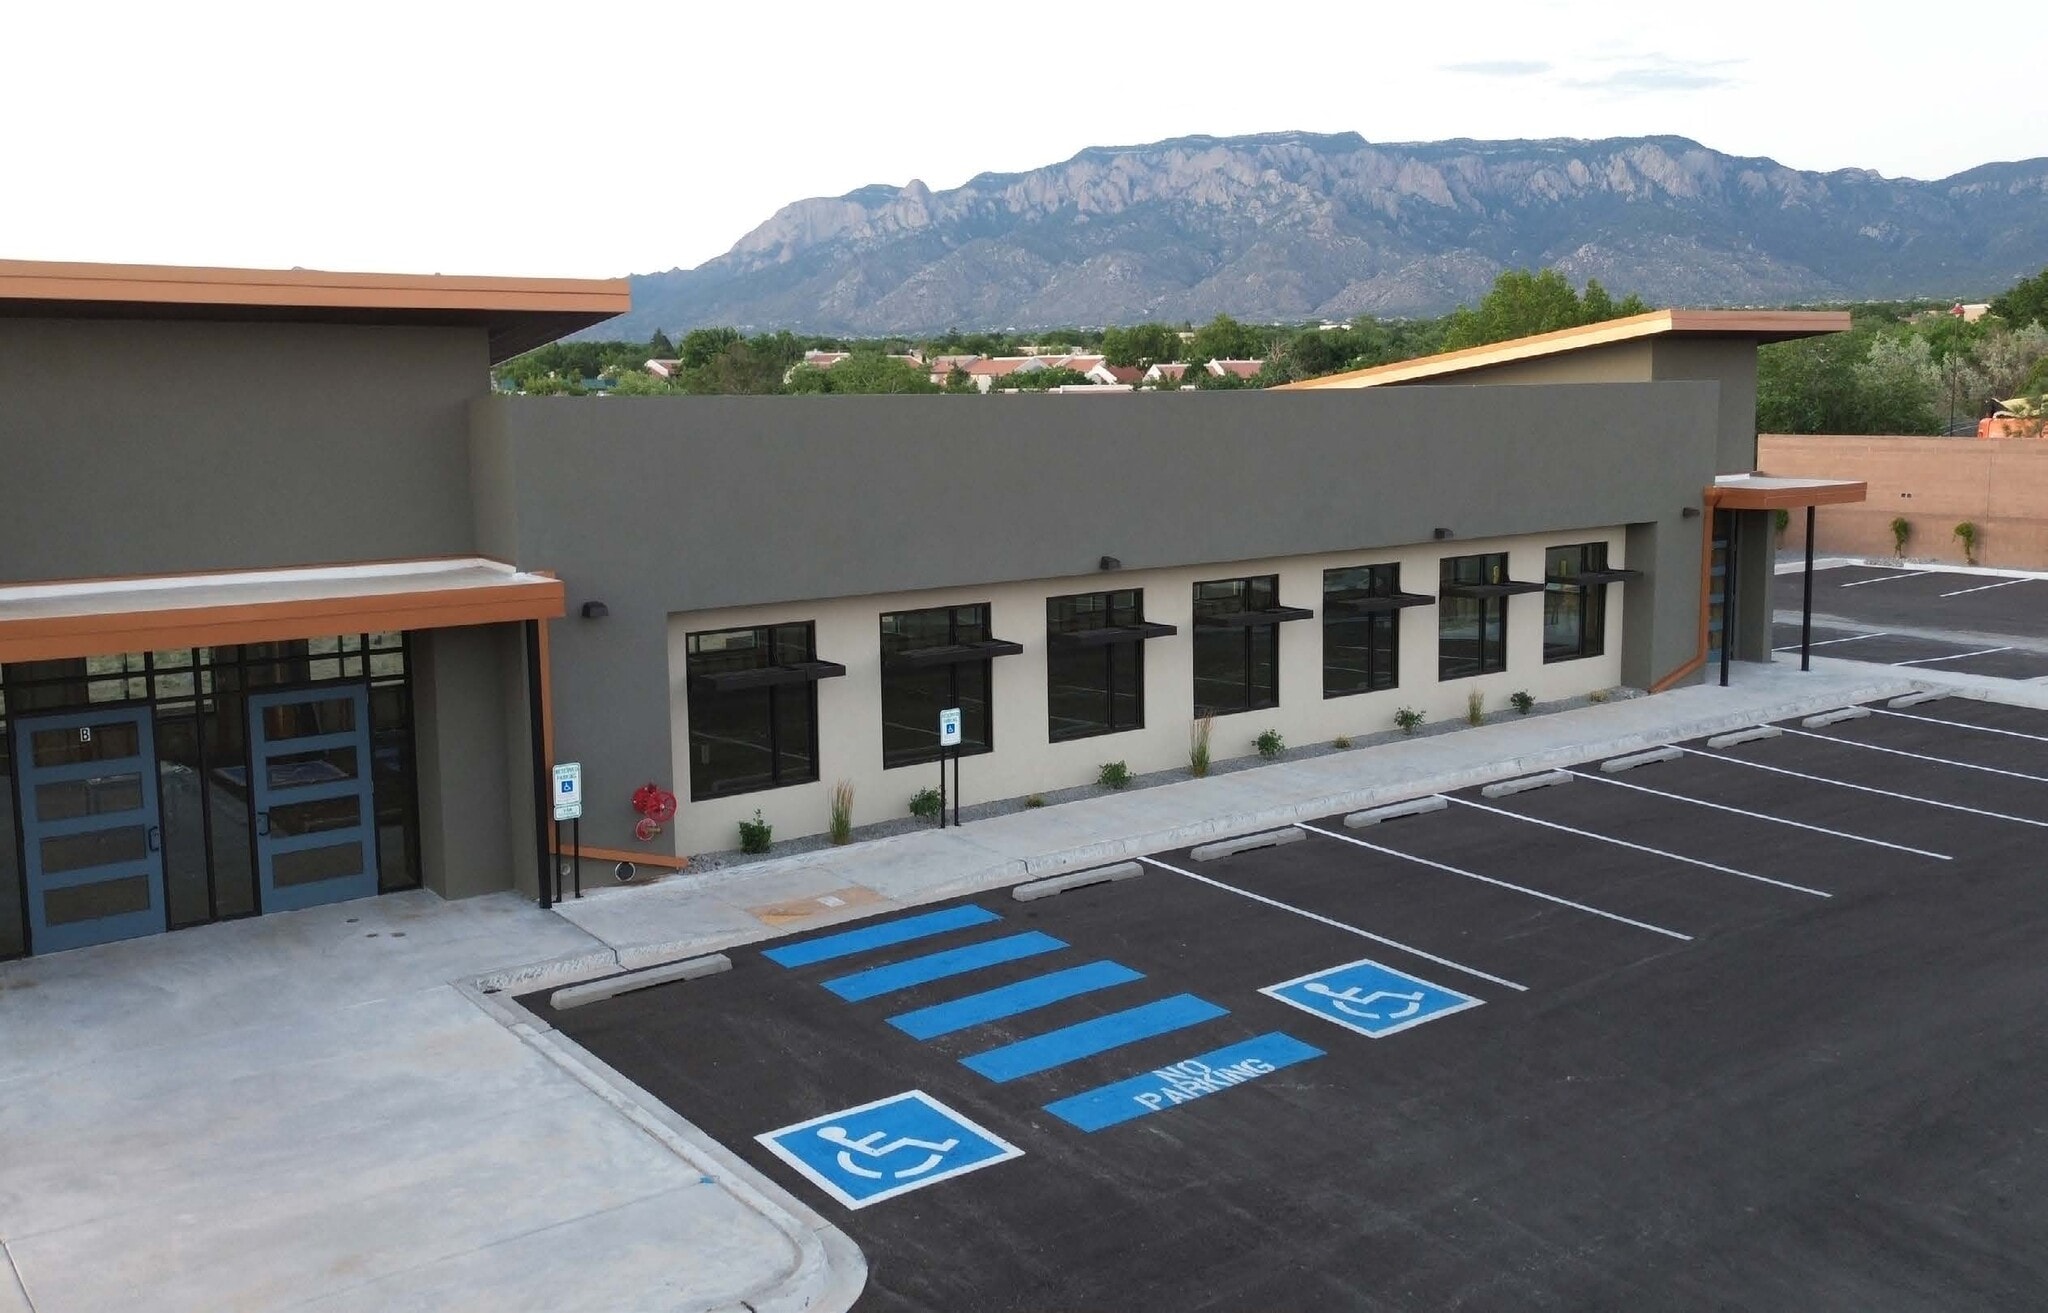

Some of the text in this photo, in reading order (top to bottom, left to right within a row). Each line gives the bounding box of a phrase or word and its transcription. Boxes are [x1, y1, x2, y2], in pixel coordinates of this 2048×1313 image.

[81, 728, 90, 741] B
[1133, 1058, 1276, 1111] PARKING
[1152, 1060, 1212, 1085] NO
